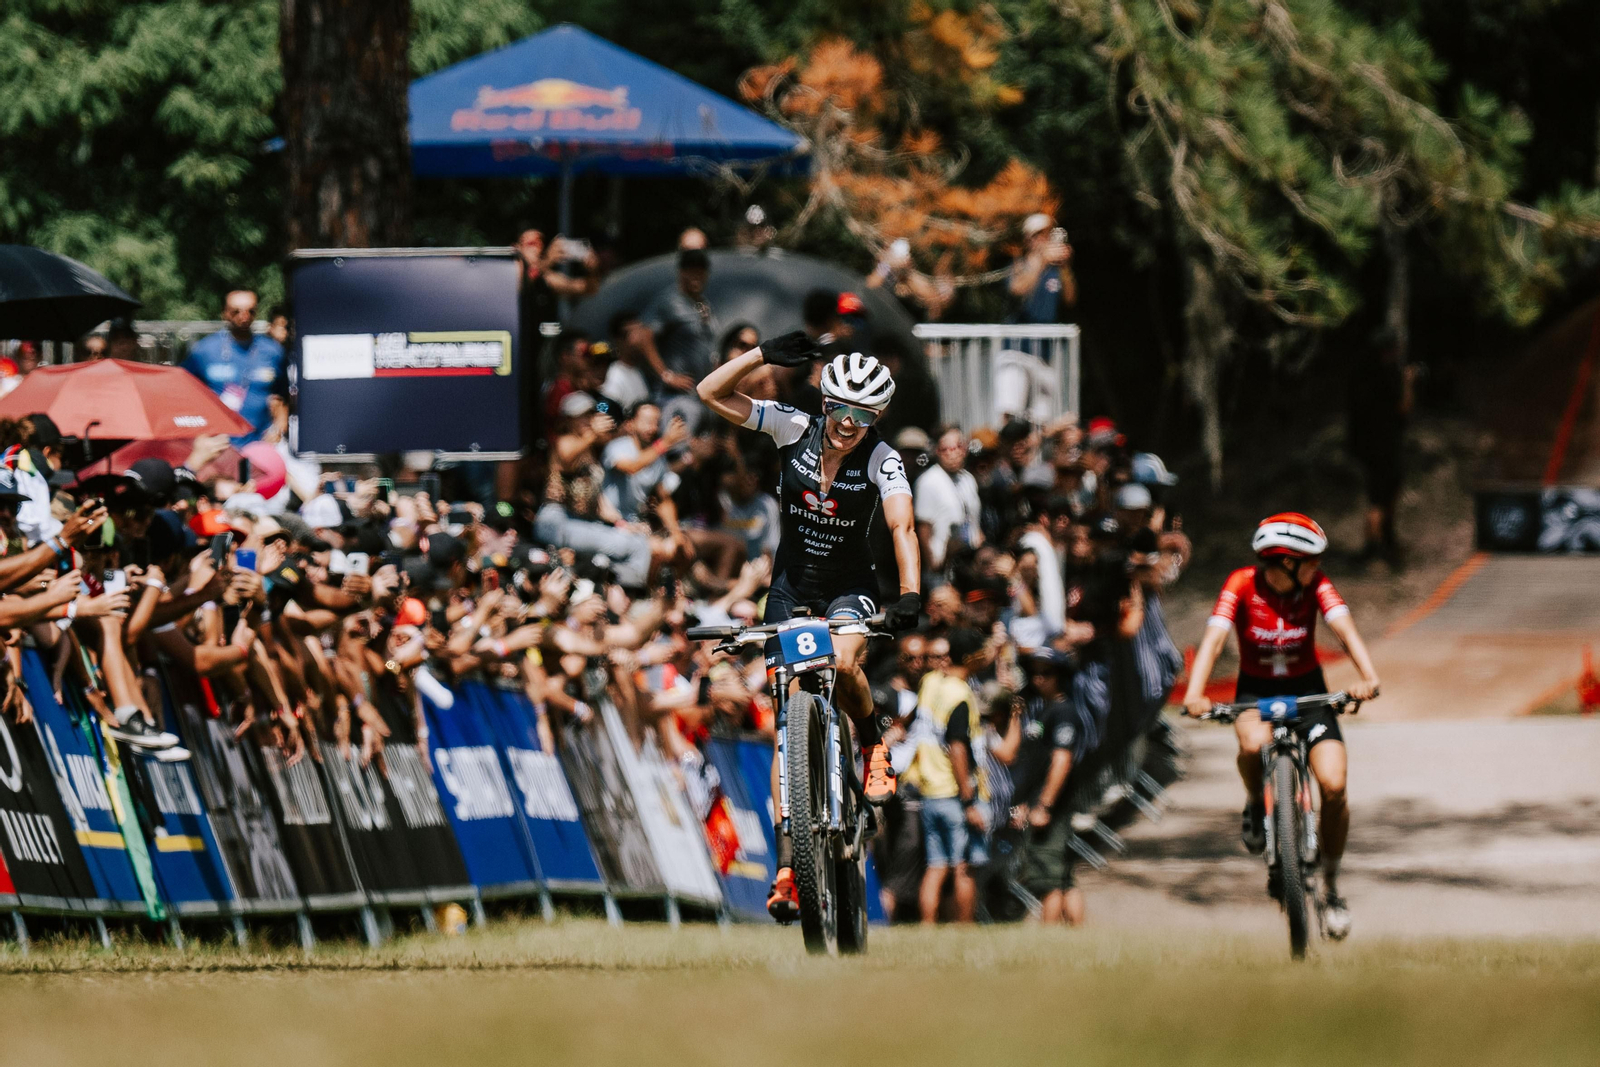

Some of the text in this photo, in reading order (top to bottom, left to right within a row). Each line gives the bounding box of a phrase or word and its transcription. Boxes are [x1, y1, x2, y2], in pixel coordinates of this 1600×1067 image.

[790, 504, 856, 527] primaflor
[798, 525, 845, 543] GENUINS
[804, 538, 833, 549] MAXXIS
[796, 632, 817, 656] 8
